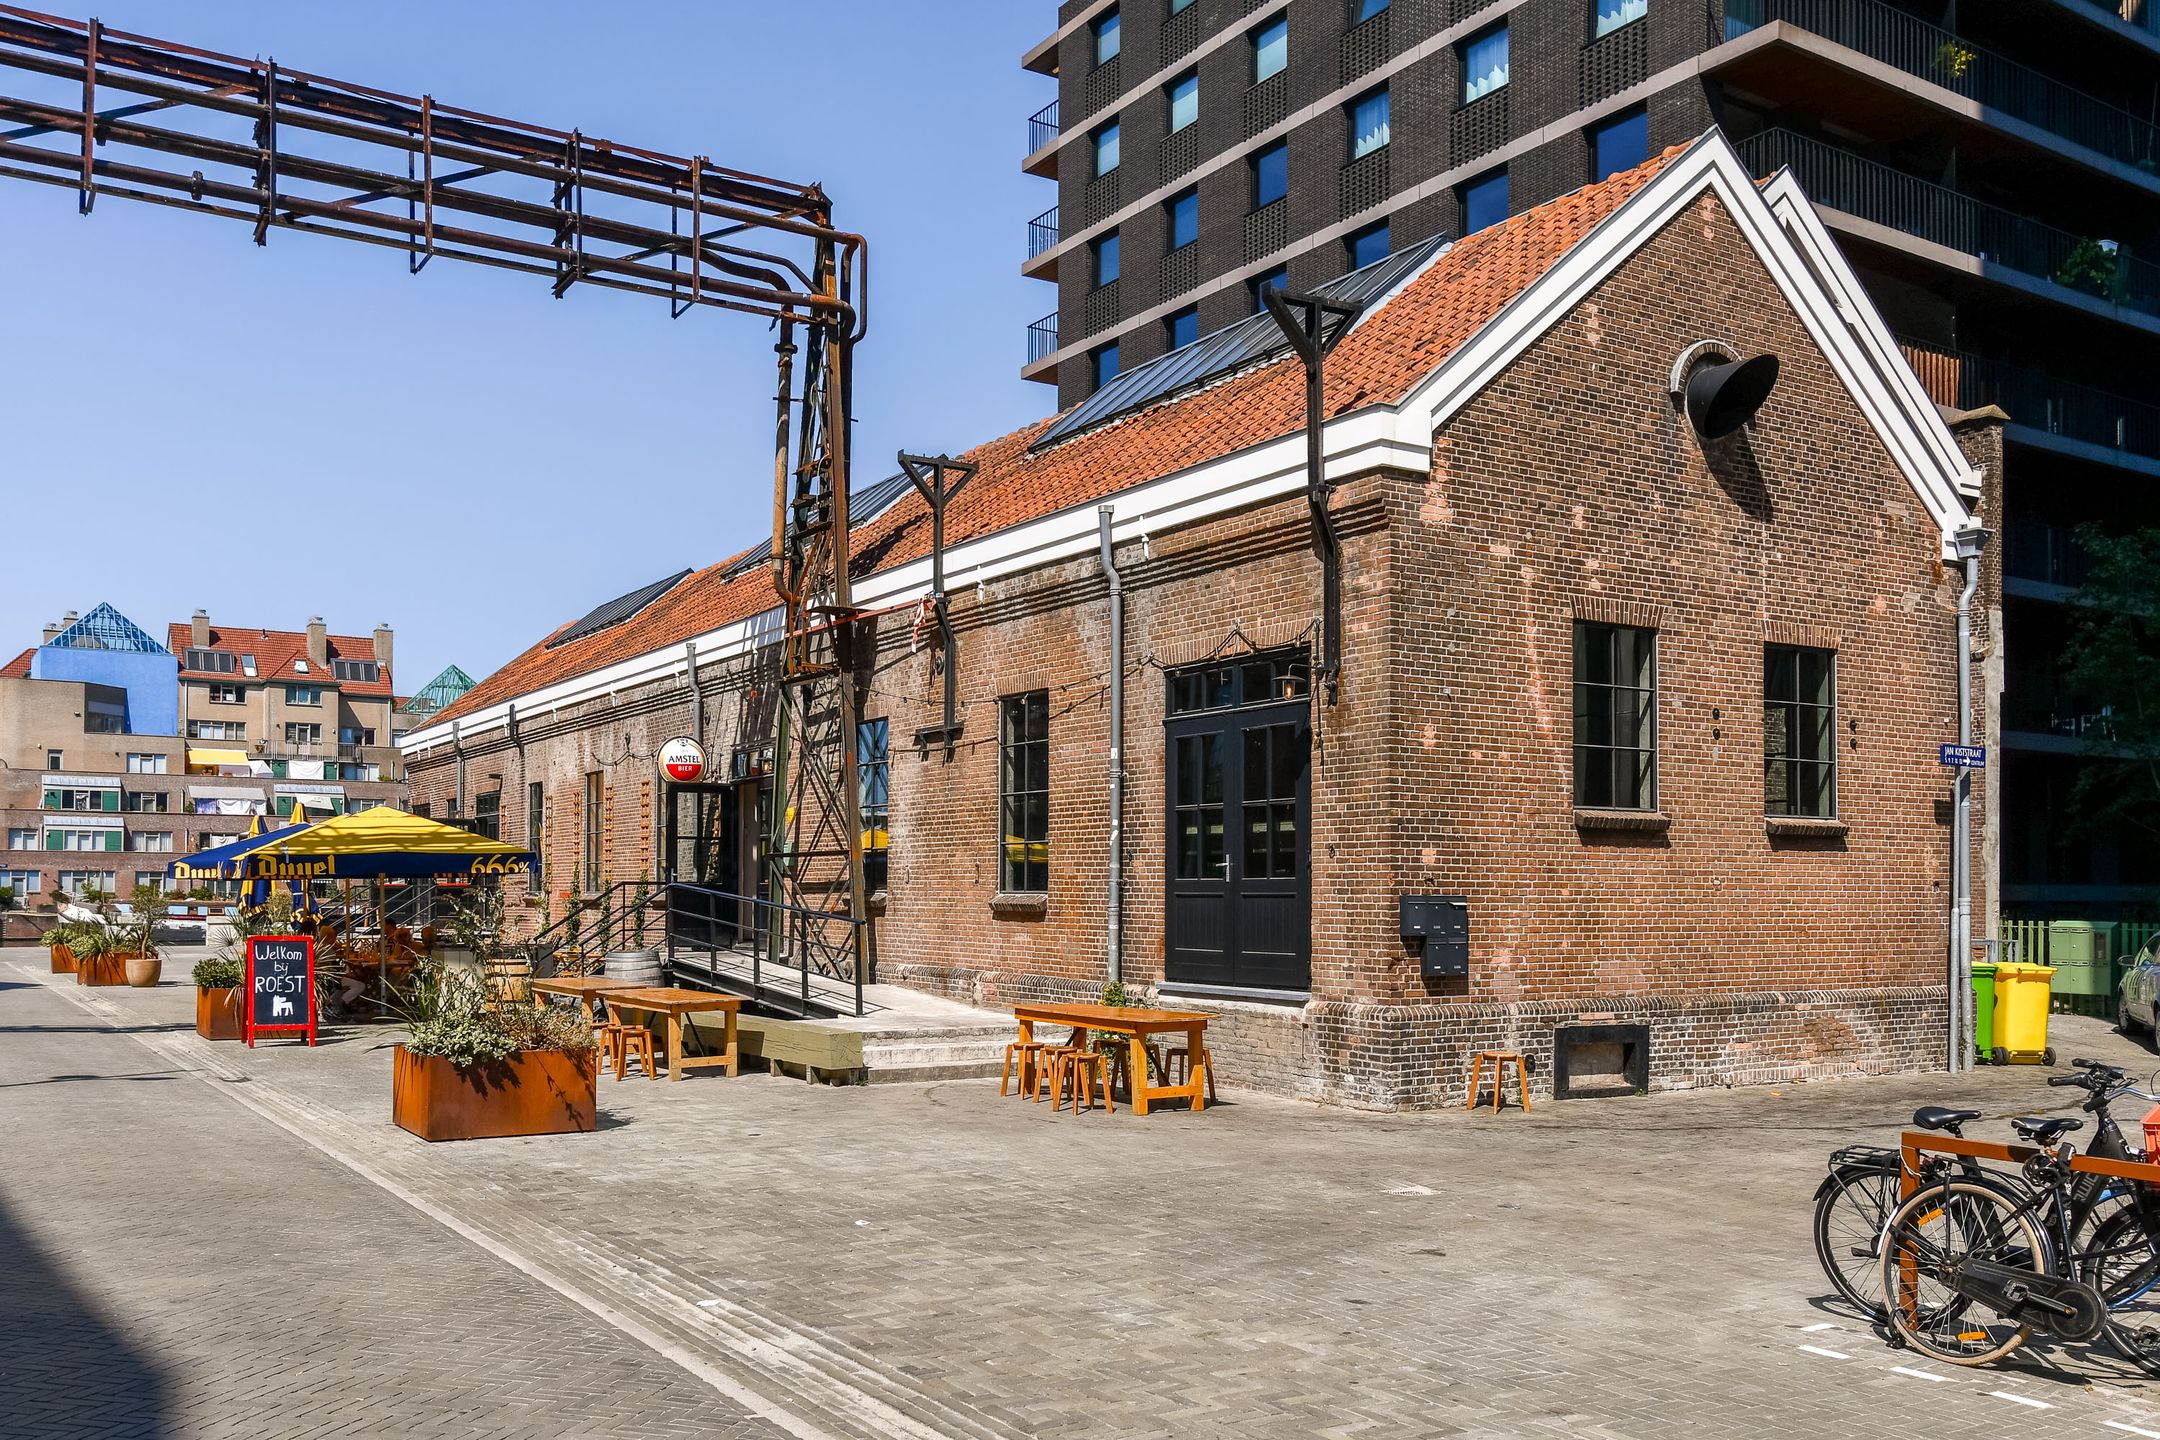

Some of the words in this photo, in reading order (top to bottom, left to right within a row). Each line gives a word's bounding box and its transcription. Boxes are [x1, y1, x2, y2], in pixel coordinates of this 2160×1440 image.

[1944, 746, 1954, 757] JAN
[668, 755, 700, 763] AMSTEL
[255, 975, 306, 994] ROEST
